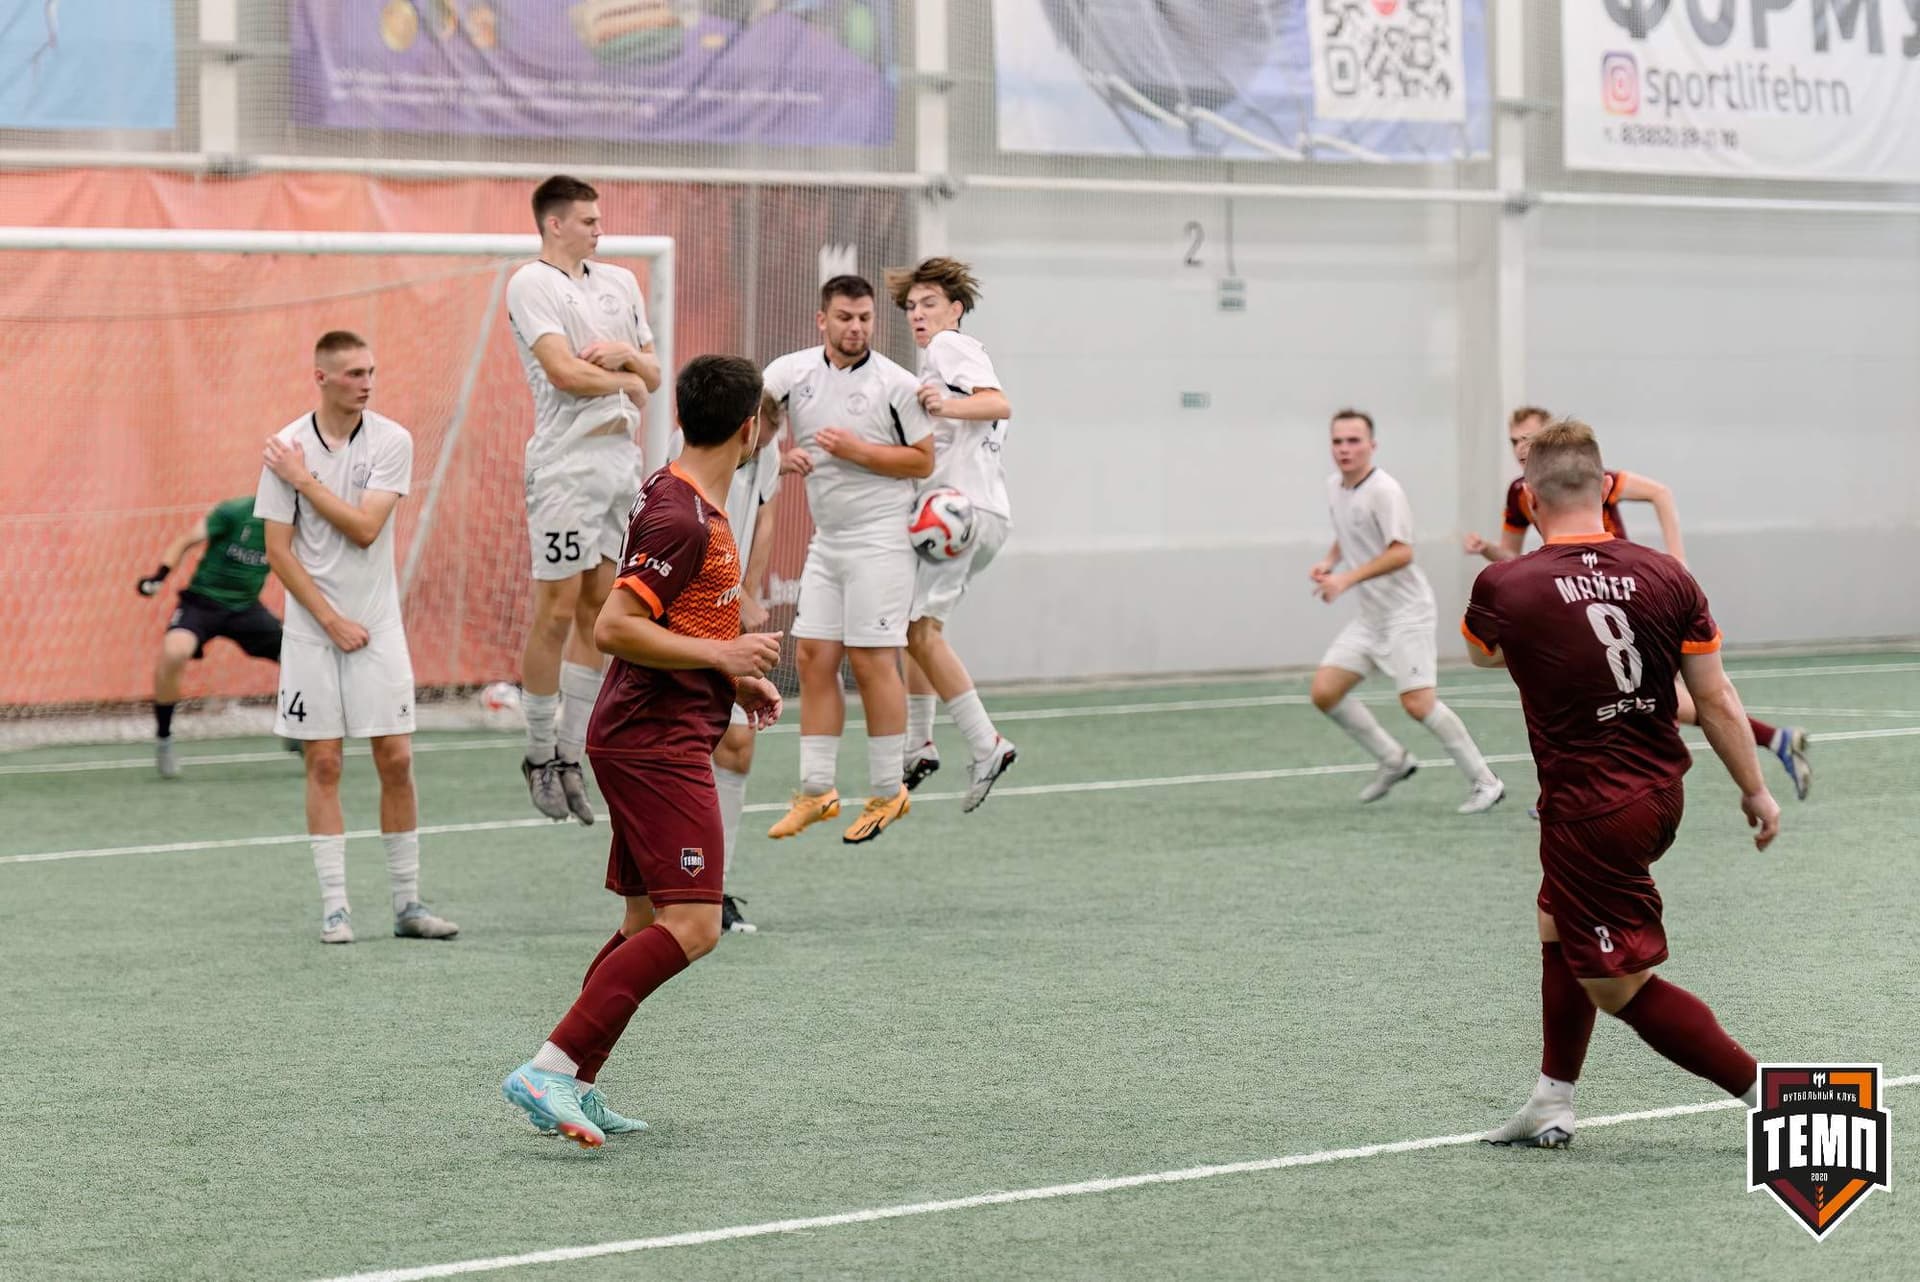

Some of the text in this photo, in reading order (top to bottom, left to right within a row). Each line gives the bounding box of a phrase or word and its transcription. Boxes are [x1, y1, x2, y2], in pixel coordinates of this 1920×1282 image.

[1645, 62, 1852, 117] sportlifebrn
[1183, 220, 1206, 268] 2
[545, 530, 581, 564] 35
[1554, 570, 1637, 605] МАЙЕР
[1586, 602, 1643, 694] 8
[1594, 925, 1615, 953] 8
